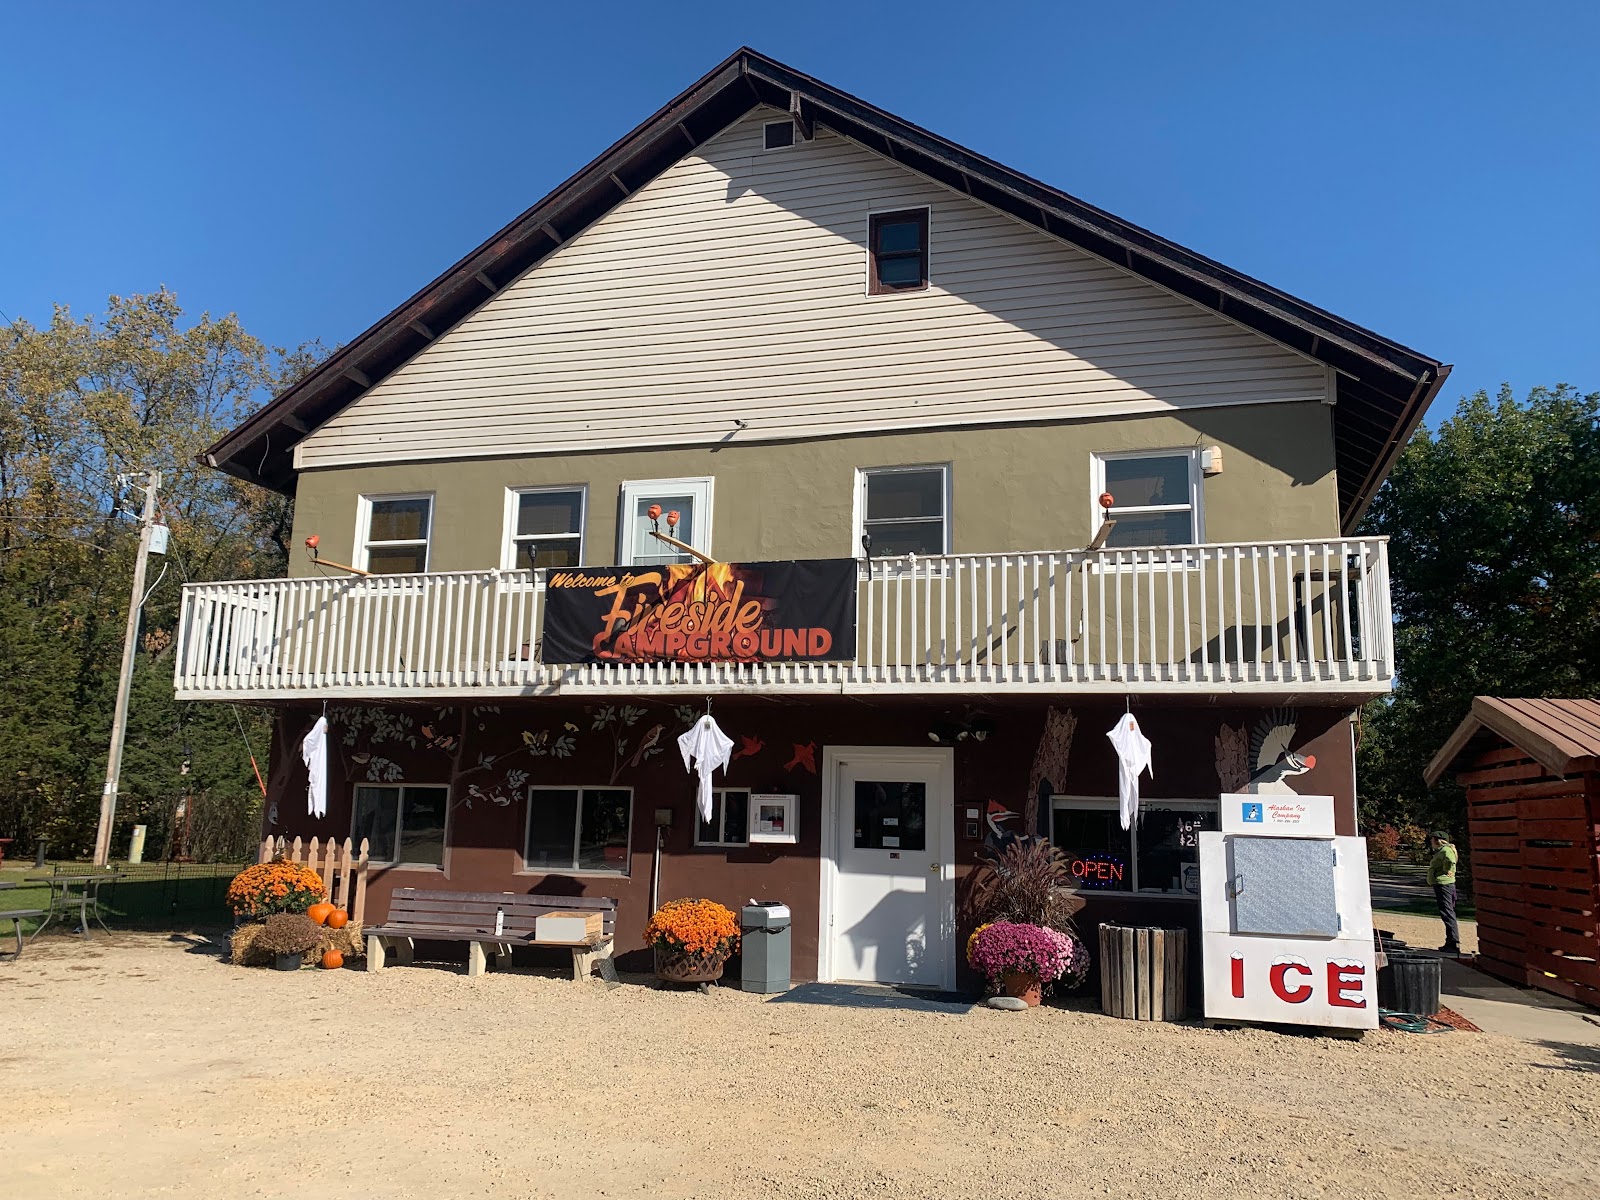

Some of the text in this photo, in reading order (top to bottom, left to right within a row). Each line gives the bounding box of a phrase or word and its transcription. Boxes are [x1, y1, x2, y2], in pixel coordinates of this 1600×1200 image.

[548, 572, 636, 589] Welcome to
[594, 572, 764, 637] Fireside
[592, 627, 833, 660] CAMPGROUND
[1272, 810, 1301, 820] Company
[1295, 804, 1306, 812] Ice
[1071, 860, 1124, 881] OPEN
[1229, 950, 1367, 1009] ICE
